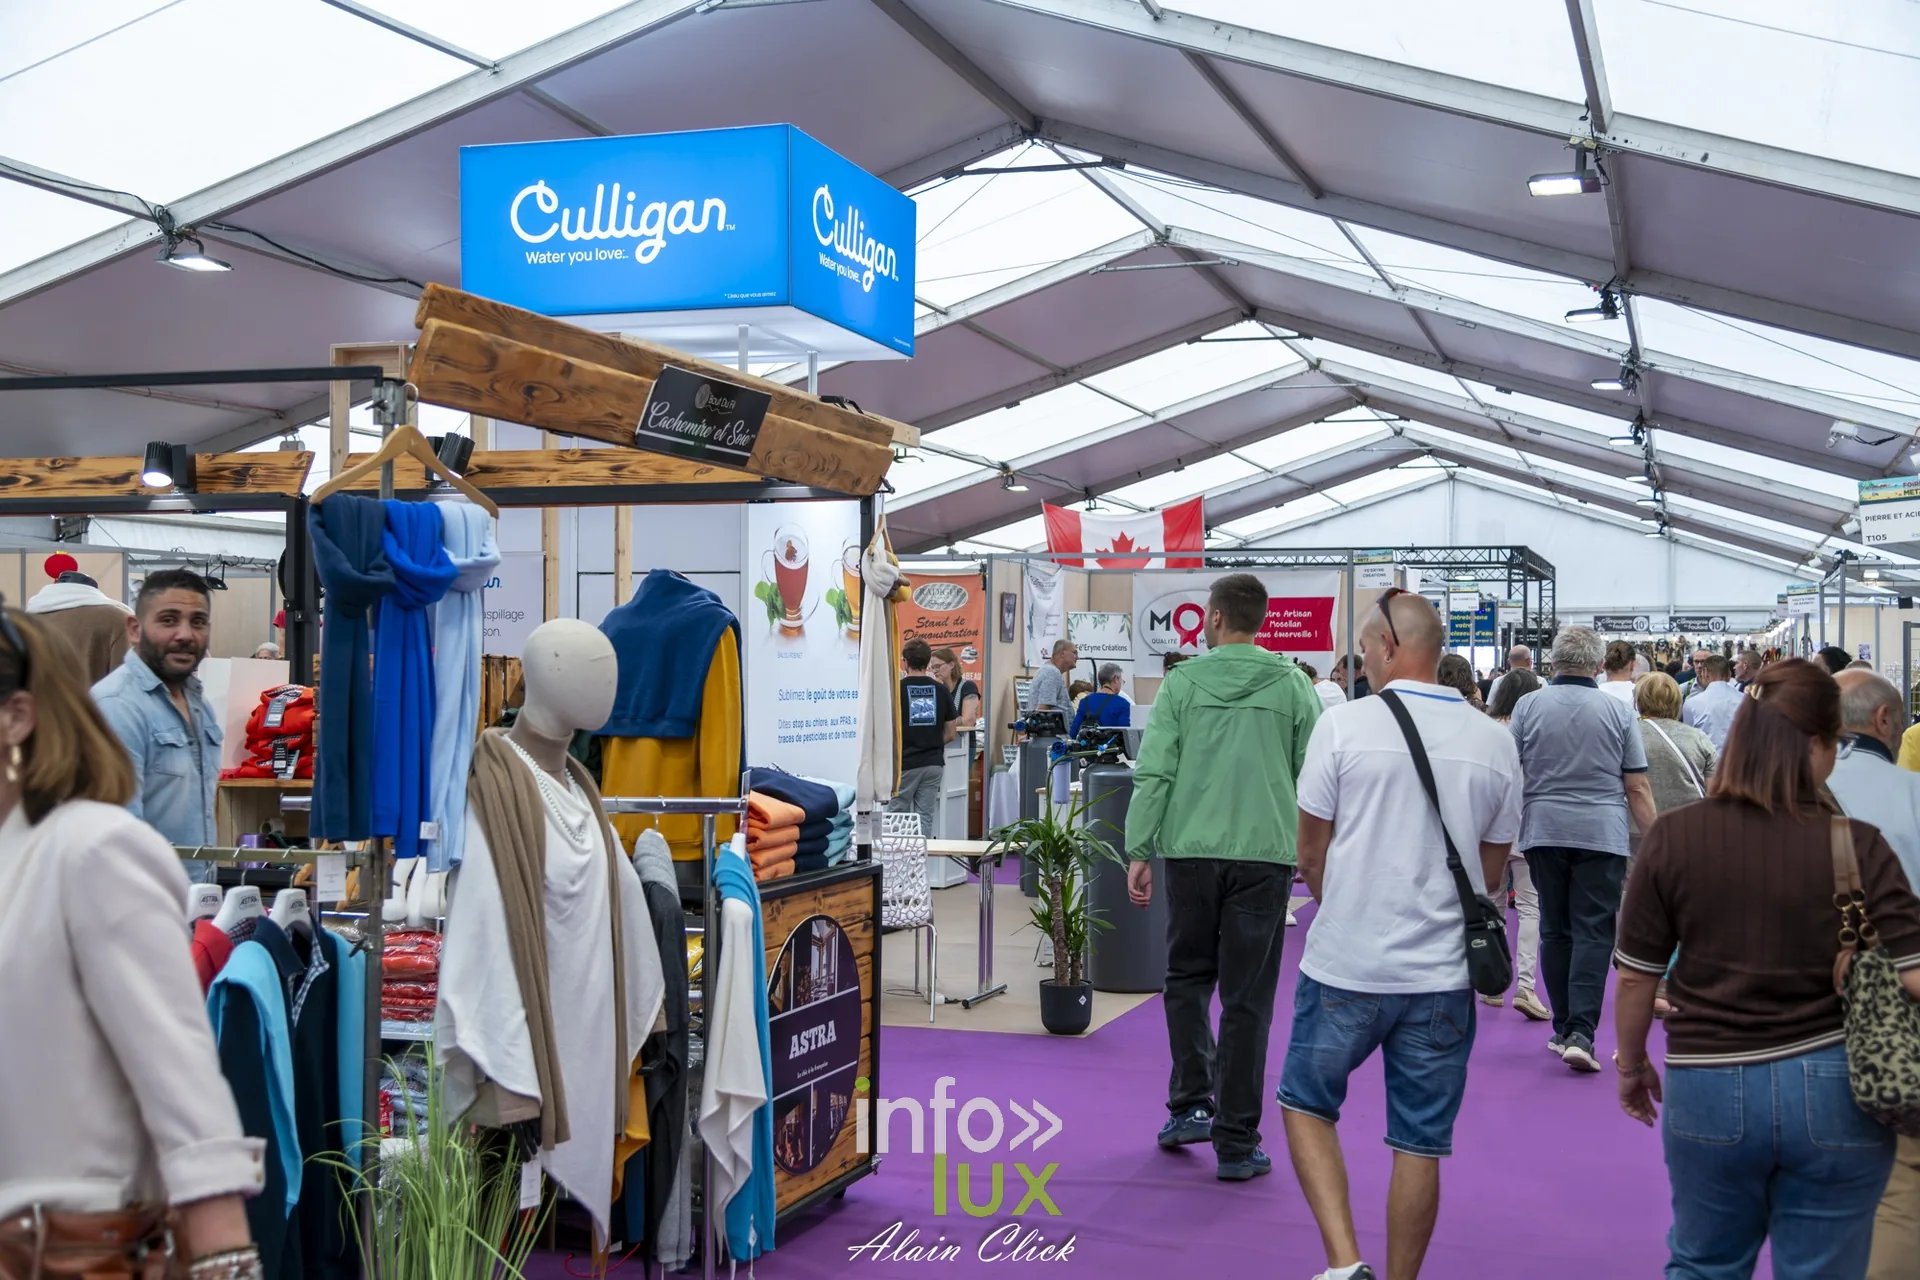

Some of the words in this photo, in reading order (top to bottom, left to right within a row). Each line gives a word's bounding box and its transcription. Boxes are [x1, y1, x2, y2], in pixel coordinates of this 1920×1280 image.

[510, 179, 727, 264] Culligan
[812, 183, 896, 292] Culligan
[525, 251, 565, 265] Water
[568, 251, 594, 266] you
[819, 251, 836, 272] Water
[836, 263, 848, 277] you
[648, 401, 714, 439] Cachemire
[713, 421, 731, 442] et
[726, 420, 752, 446] Soie
[1865, 514, 1892, 522] PIERRE
[1866, 534, 1887, 542] T105
[1283, 609, 1312, 618] Artisan
[916, 616, 950, 628] Stand
[953, 615, 966, 626] de
[1269, 620, 1302, 628] Mosellan
[903, 628, 979, 641] Démonstration
[1274, 629, 1312, 639] émerveille
[1101, 643, 1128, 653] Créations
[778, 688, 805, 701] Sublimez
[806, 688, 812, 700] le
[813, 688, 827, 703] goût
[828, 688, 835, 700] de
[836, 689, 850, 699] votre
[778, 719, 791, 729] Dites
[792, 718, 804, 730] stop
[805, 719, 811, 728] au
[830, 718, 839, 727] aux
[778, 734, 794, 744] traces
[795, 732, 802, 742] de
[802, 731, 827, 744] pesticides
[828, 731, 834, 740] et
[834, 731, 841, 740] de
[841, 729, 856, 739] nitrate
[789, 1020, 837, 1060] ASTRA
